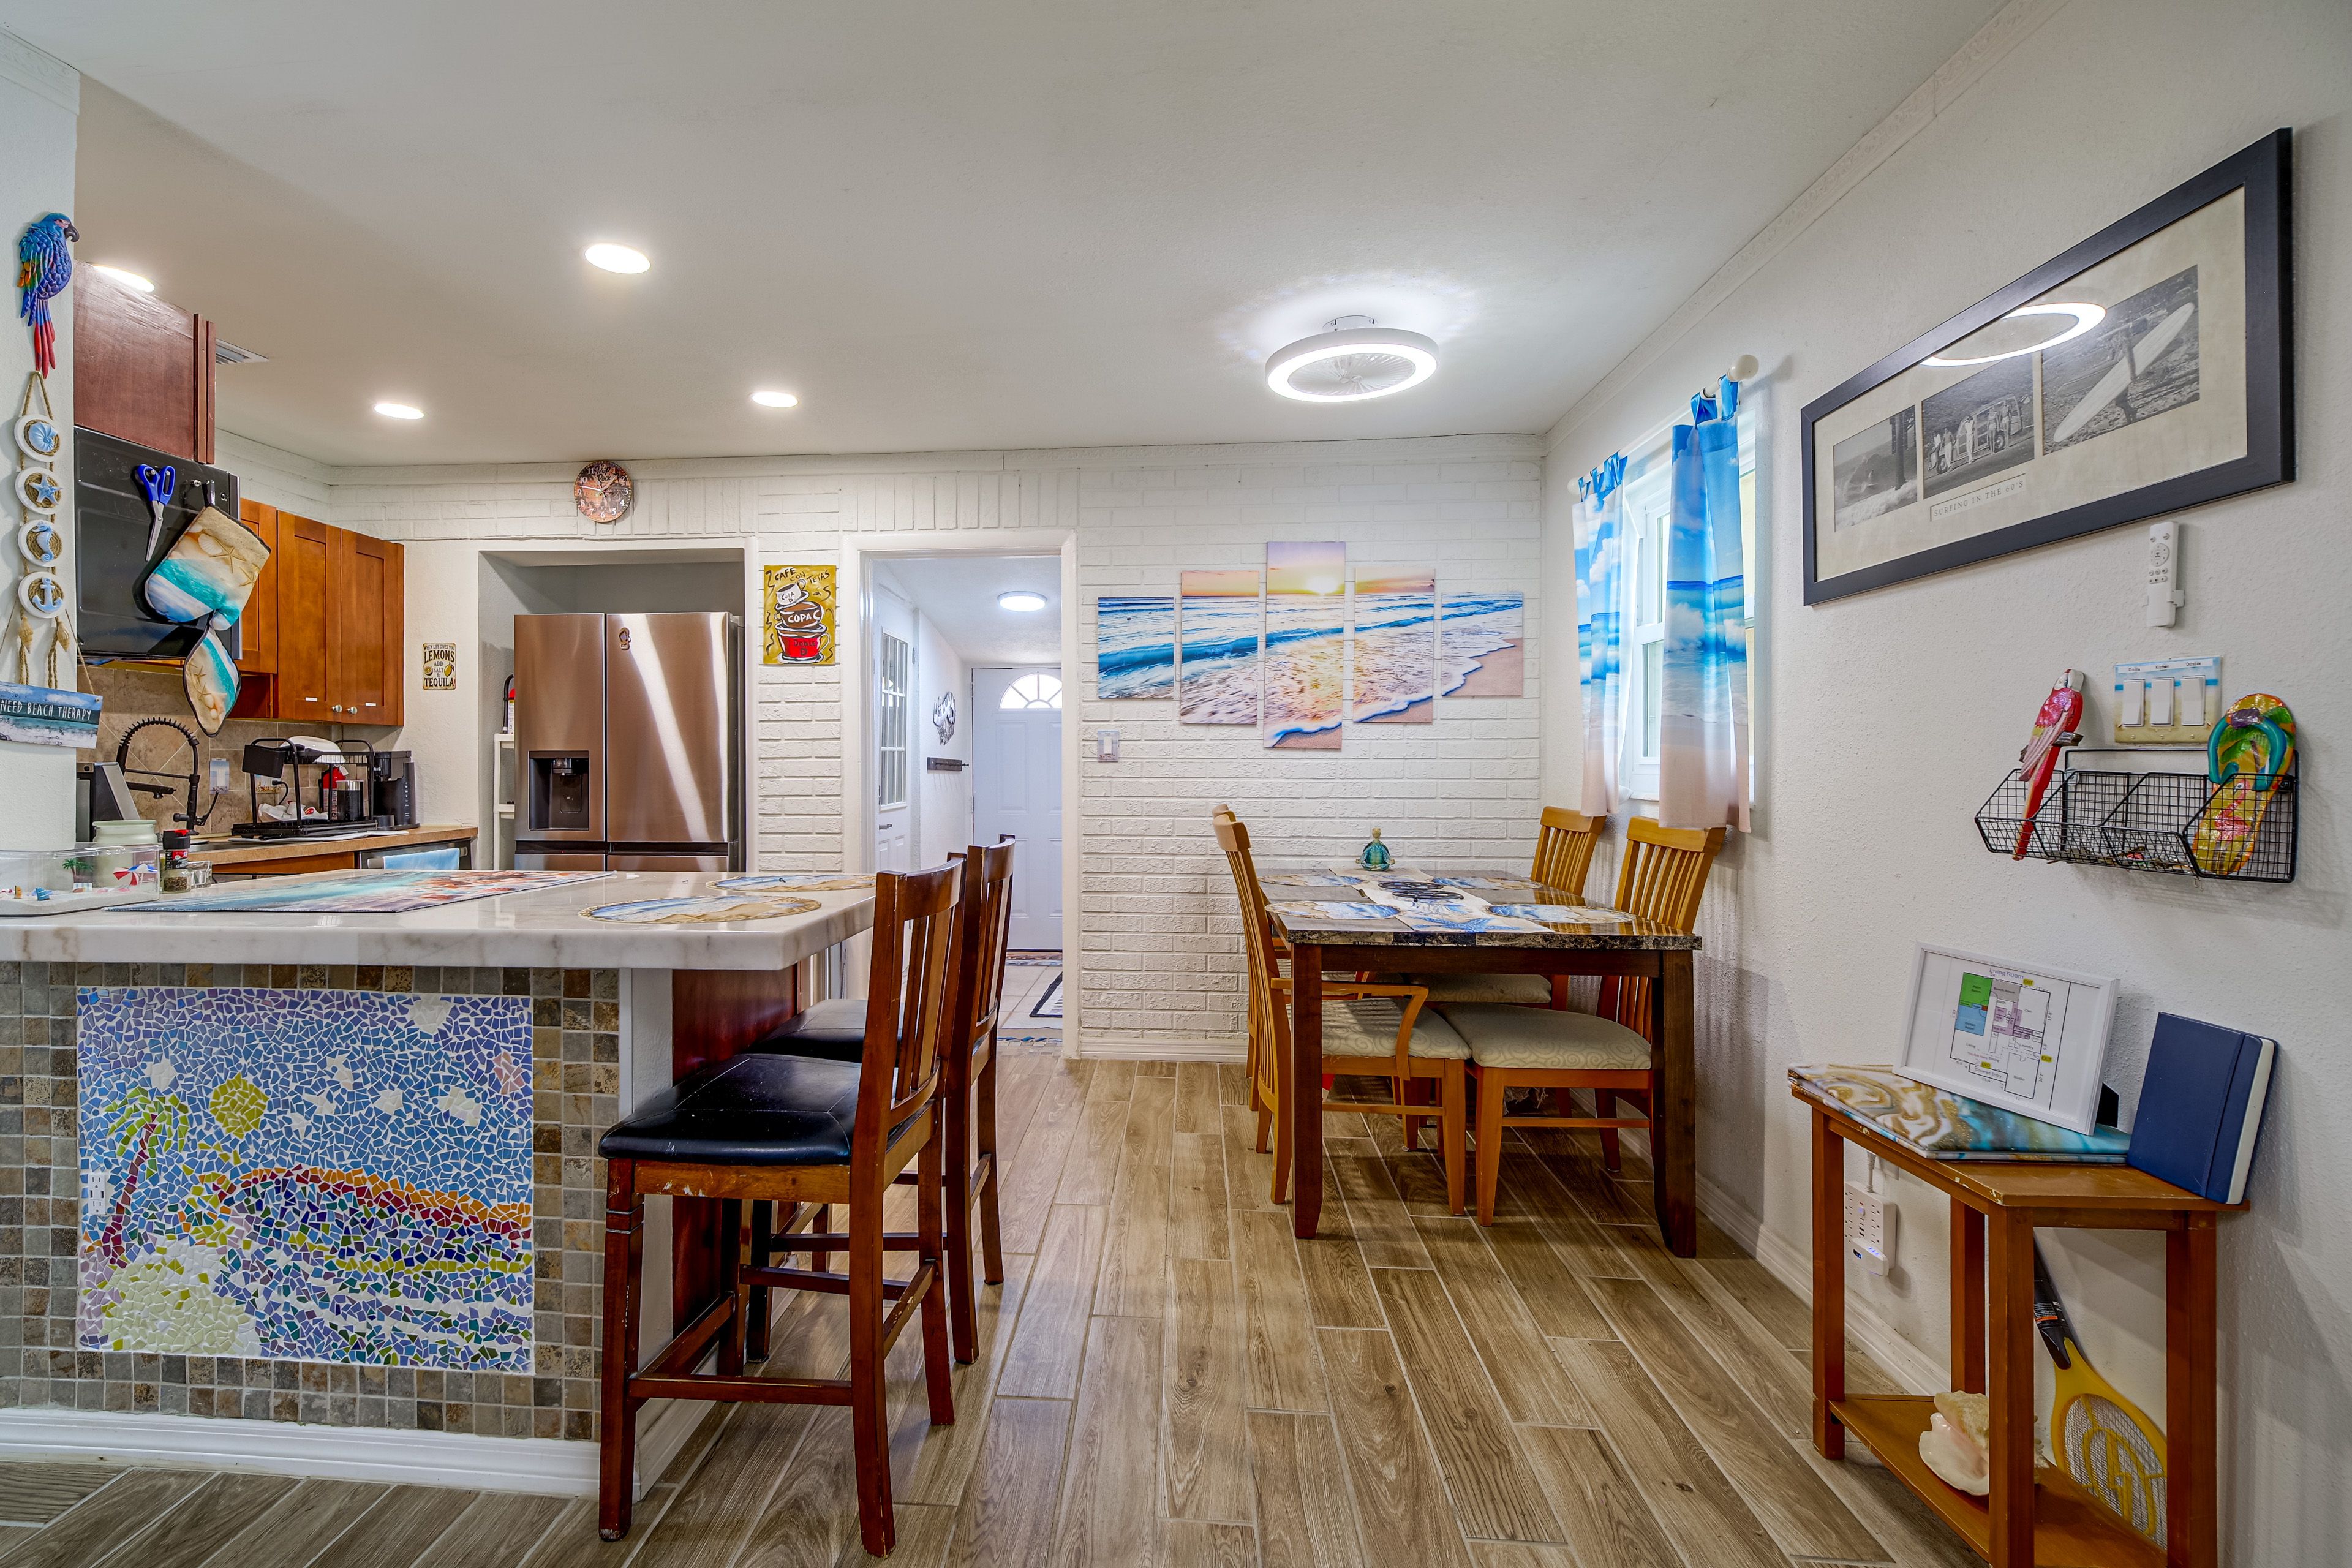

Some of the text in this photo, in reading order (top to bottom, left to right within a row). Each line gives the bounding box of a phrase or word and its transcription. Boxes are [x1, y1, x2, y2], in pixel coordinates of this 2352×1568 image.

[597, 474, 611, 484] Rock
[1934, 480, 2023, 517] SURFING IN THE 60'S
[775, 567, 830, 584] CAFE CON TETAS
[782, 592, 794, 600] COPA
[788, 609, 820, 623] COPA C
[424, 650, 454, 665] LEMONS
[424, 677, 454, 687] TEQUILA
[0, 700, 91, 721] NEED BEACH THERAPY
